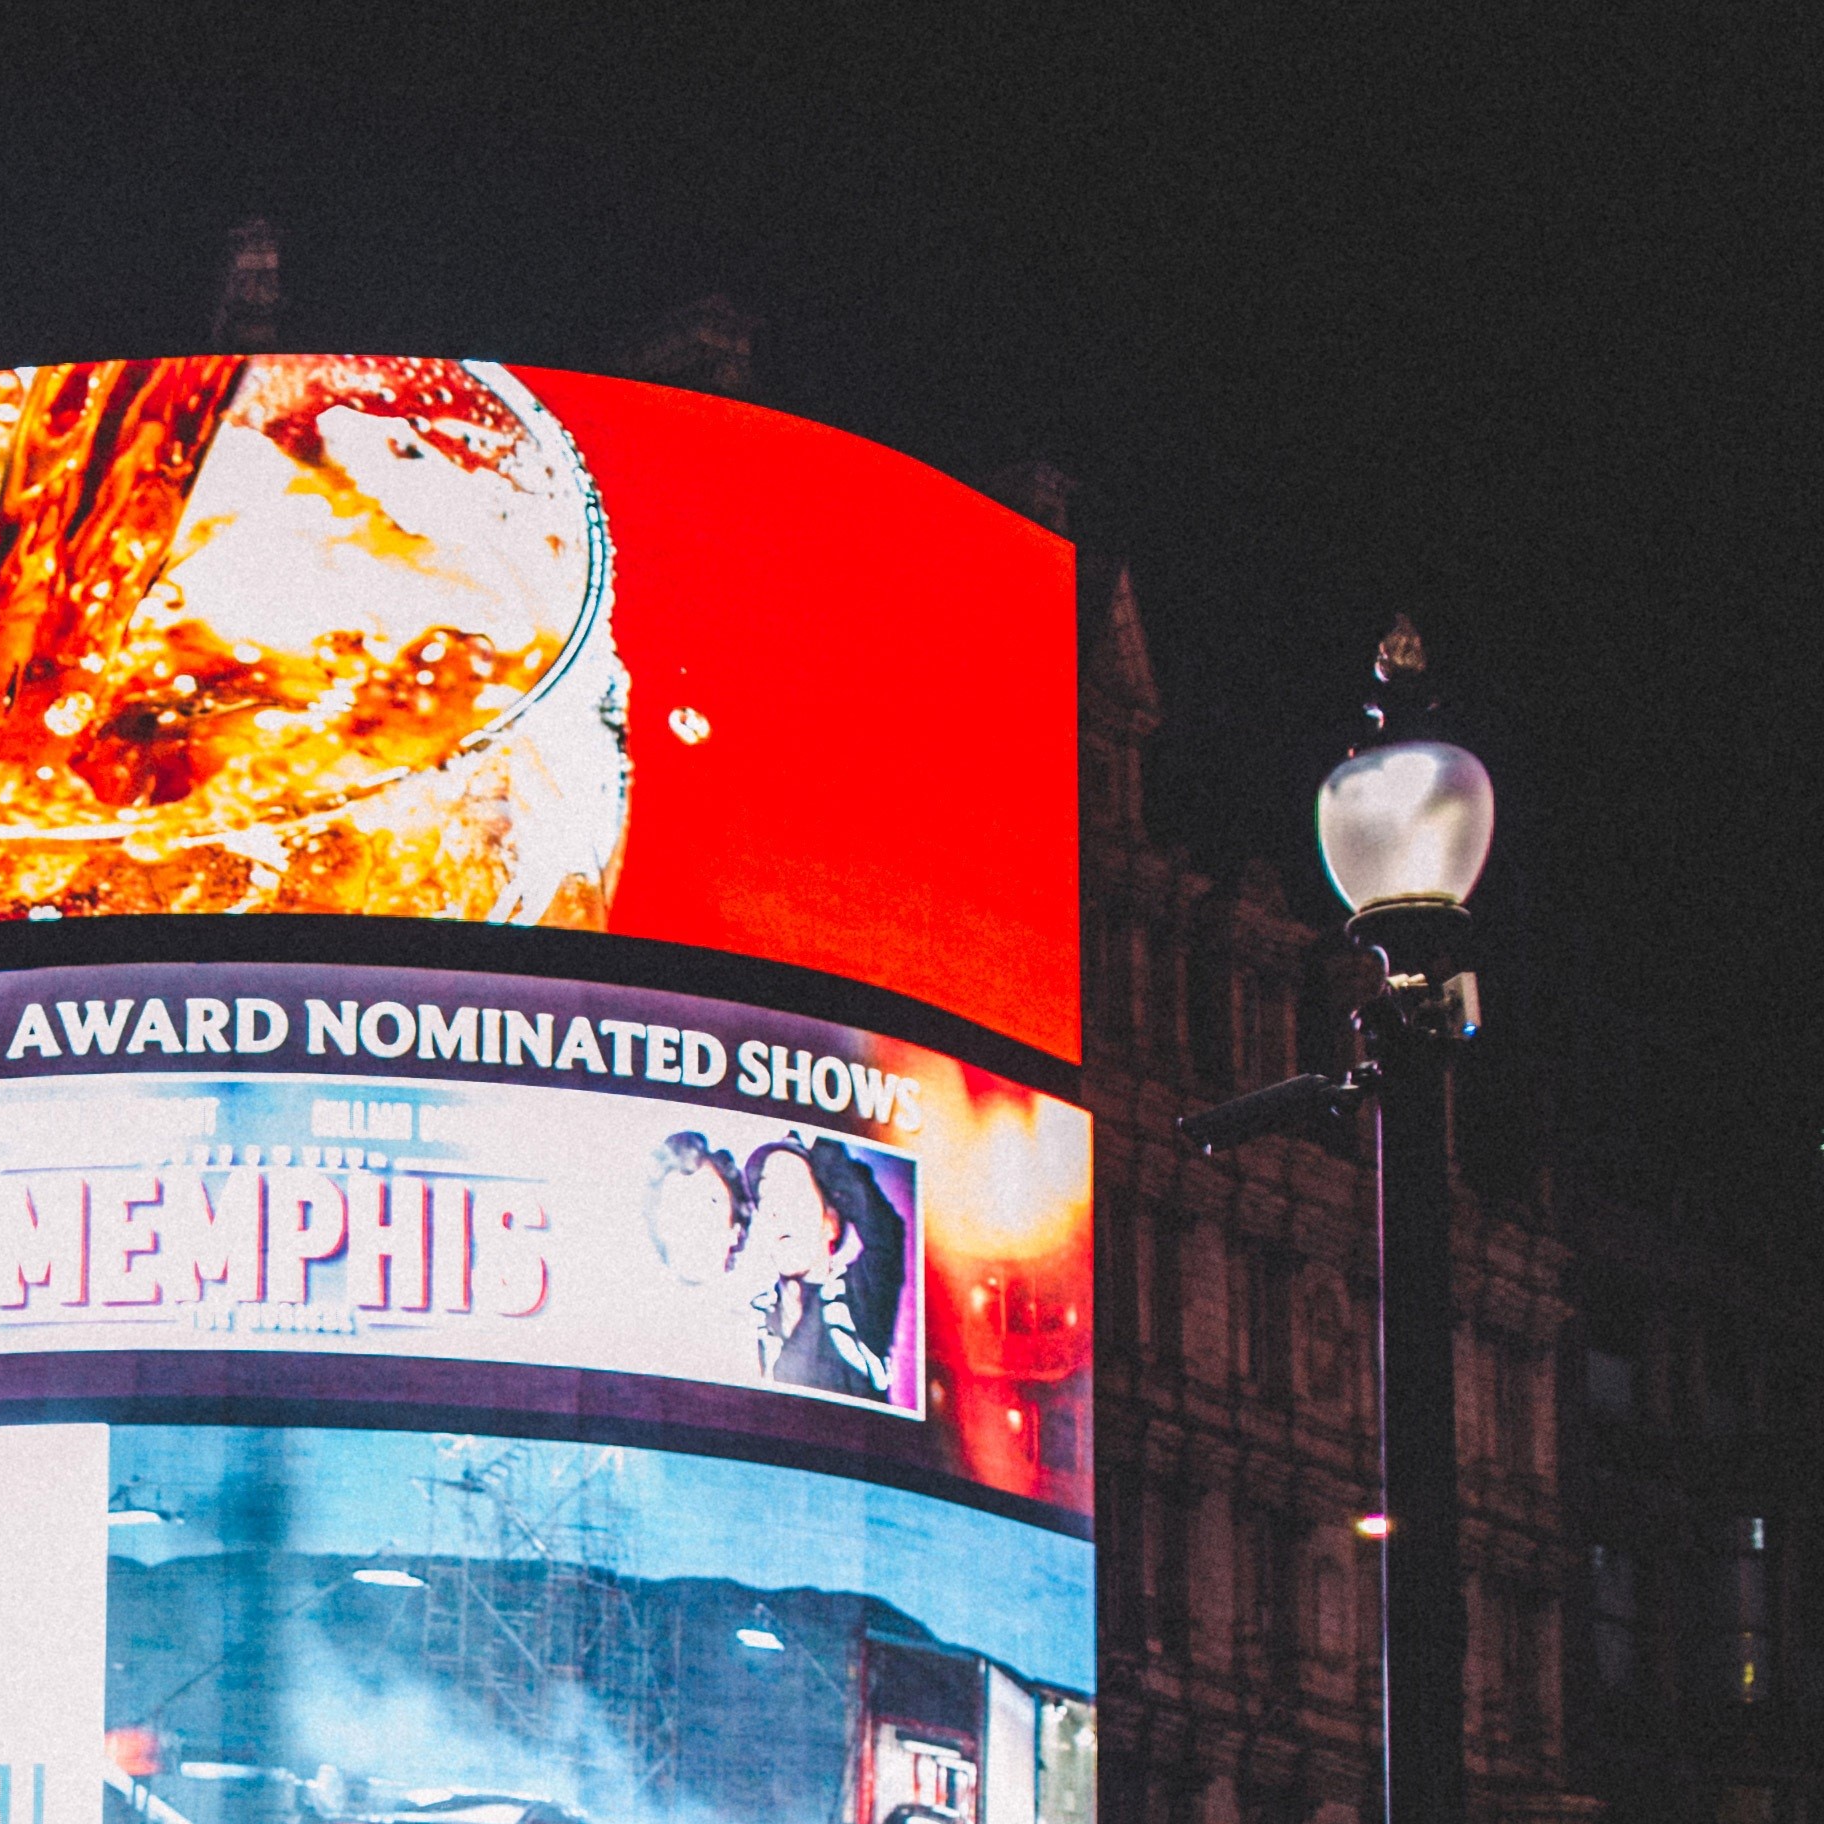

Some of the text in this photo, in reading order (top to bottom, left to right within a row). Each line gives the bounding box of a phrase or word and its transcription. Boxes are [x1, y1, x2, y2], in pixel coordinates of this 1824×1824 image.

[5, 996, 289, 1060] AWARD
[304, 998, 728, 1090] NOMINATED
[736, 1038, 923, 1134] SHOWS
